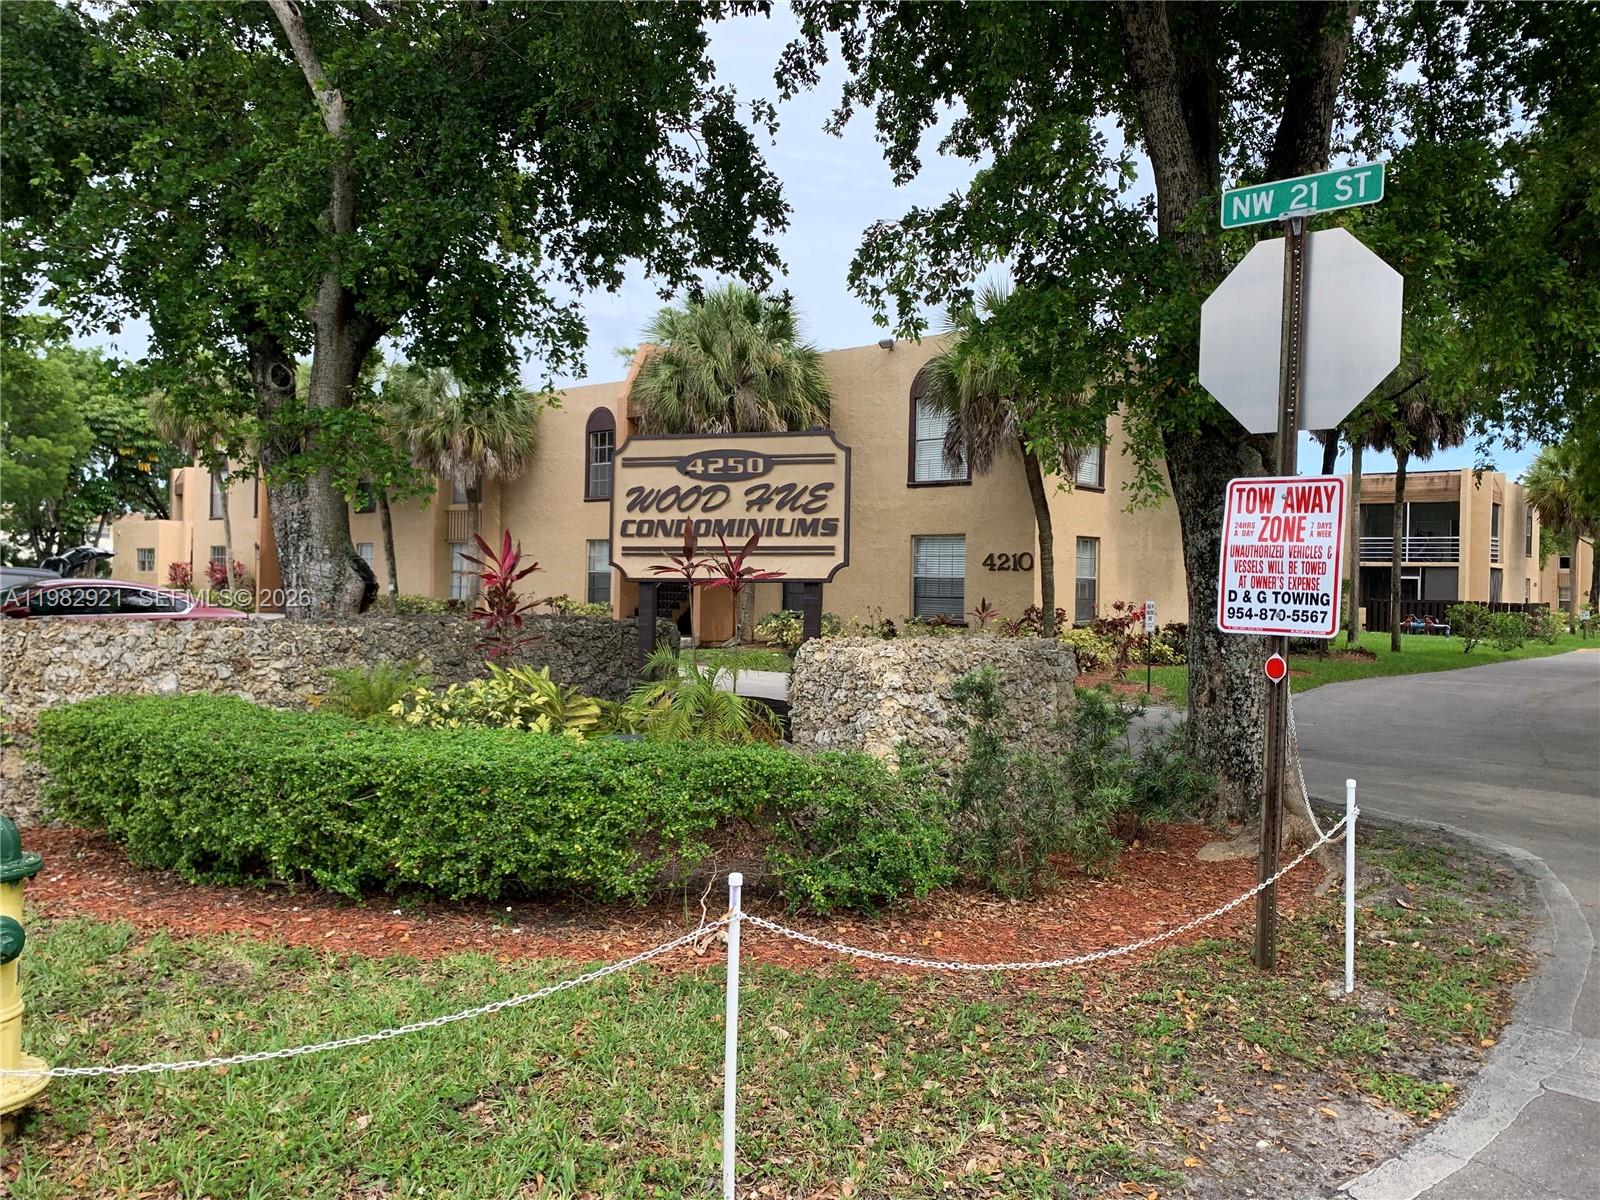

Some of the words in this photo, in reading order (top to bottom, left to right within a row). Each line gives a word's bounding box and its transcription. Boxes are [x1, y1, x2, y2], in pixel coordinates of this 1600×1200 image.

[1232, 190, 1274, 221] NW
[1289, 181, 1318, 210] 21
[1334, 171, 1372, 202] ST
[686, 457, 764, 474] 4250
[625, 483, 731, 513] WOOD
[743, 482, 835, 515] HUE
[1236, 487, 1275, 514] TOW
[1282, 485, 1336, 514] AWAY
[620, 517, 839, 538] CONDOMINIUMS
[1258, 515, 1307, 542] ZONE
[1311, 522, 1315, 530] 7
[1316, 522, 1333, 530] DAYS
[1316, 530, 1332, 538] WEEK
[982, 551, 1034, 571] 4210
[1230, 545, 1285, 559] UNAUTHORIZED
[1288, 545, 1323, 559] VEHICLES
[1327, 545, 1332, 560] &
[1234, 560, 1264, 574] VESSELS
[1267, 560, 1285, 575] WILL
[1288, 561, 1299, 575] BE
[1301, 561, 1327, 576] TOWED
[1238, 575, 1247, 588] AT
[1250, 576, 1285, 590] OWNER'S
[1288, 577, 1320, 591] EXPENSE
[1228, 590, 1238, 603] D
[1242, 590, 1252, 603] &
[1257, 590, 1267, 604] G
[1272, 591, 1331, 606] TOWING
[1227, 607, 1328, 624] 954-870-5567
